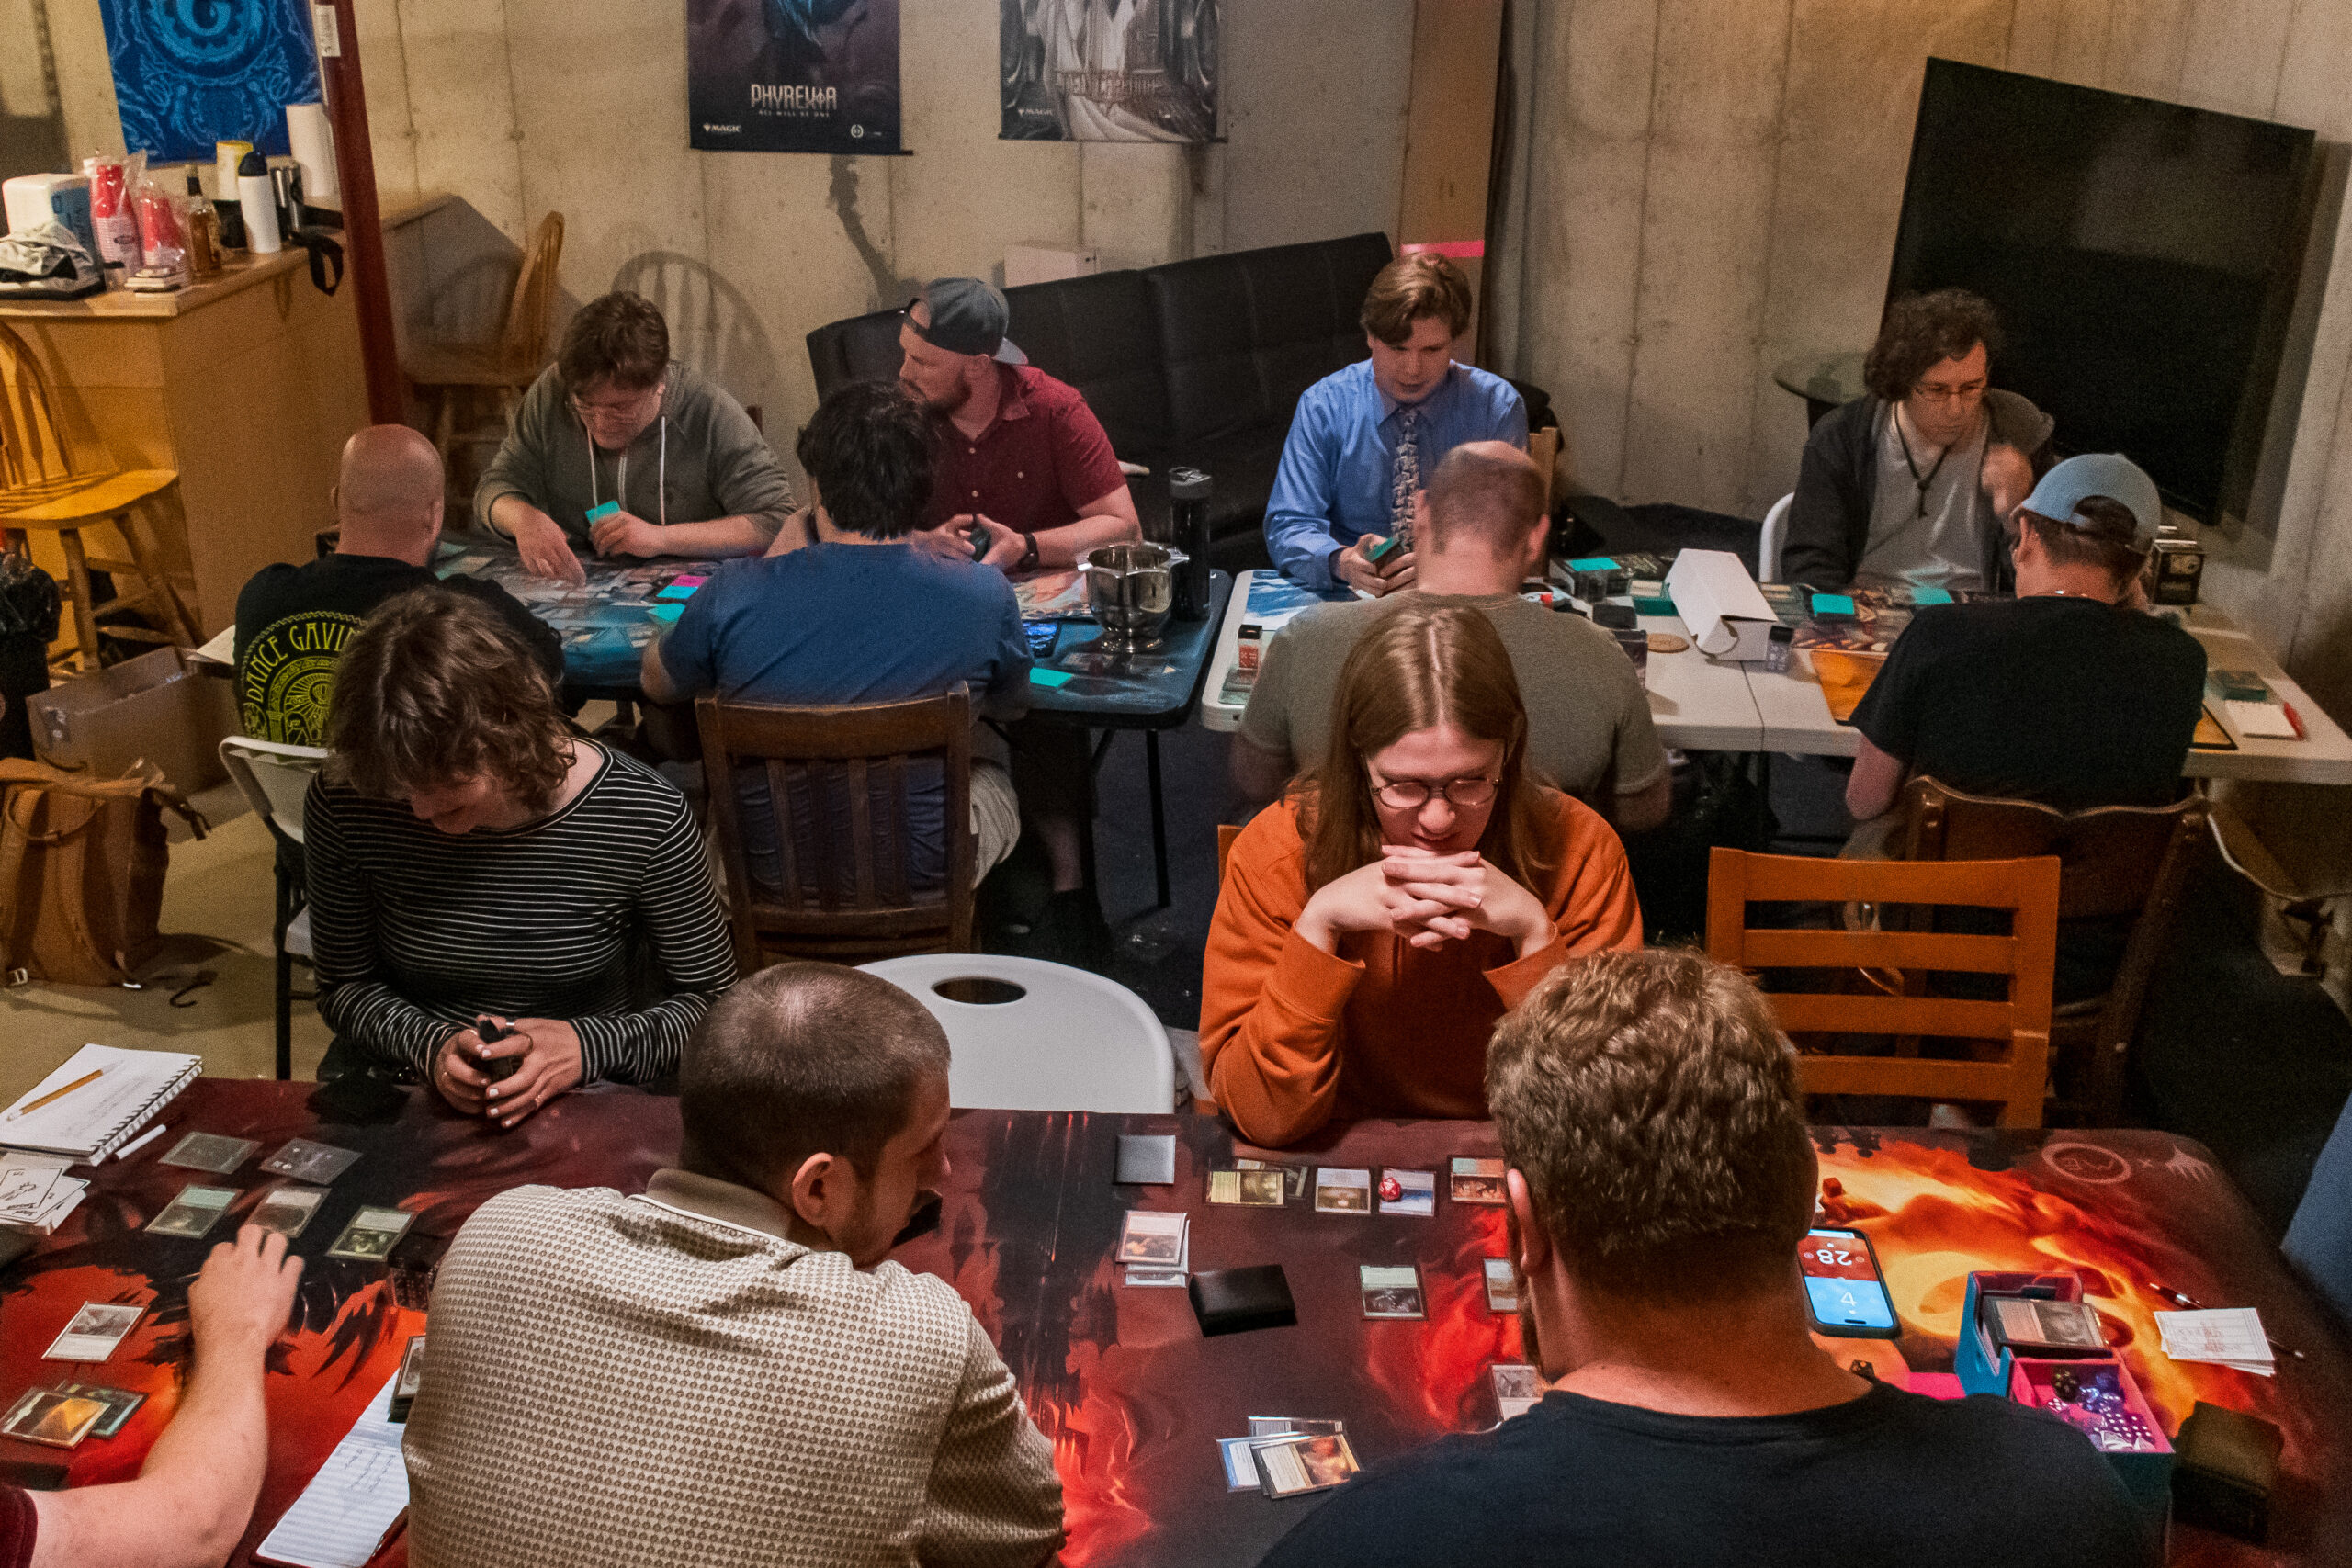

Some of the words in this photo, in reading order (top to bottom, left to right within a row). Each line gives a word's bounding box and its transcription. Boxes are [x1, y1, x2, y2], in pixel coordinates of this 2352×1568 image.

[751, 84, 837, 109] PHYREXIA
[711, 124, 741, 133] MAGIC
[246, 635, 288, 703] DANCE
[1816, 1248, 1853, 1266] 28
[1840, 1292, 1858, 1306] 4
